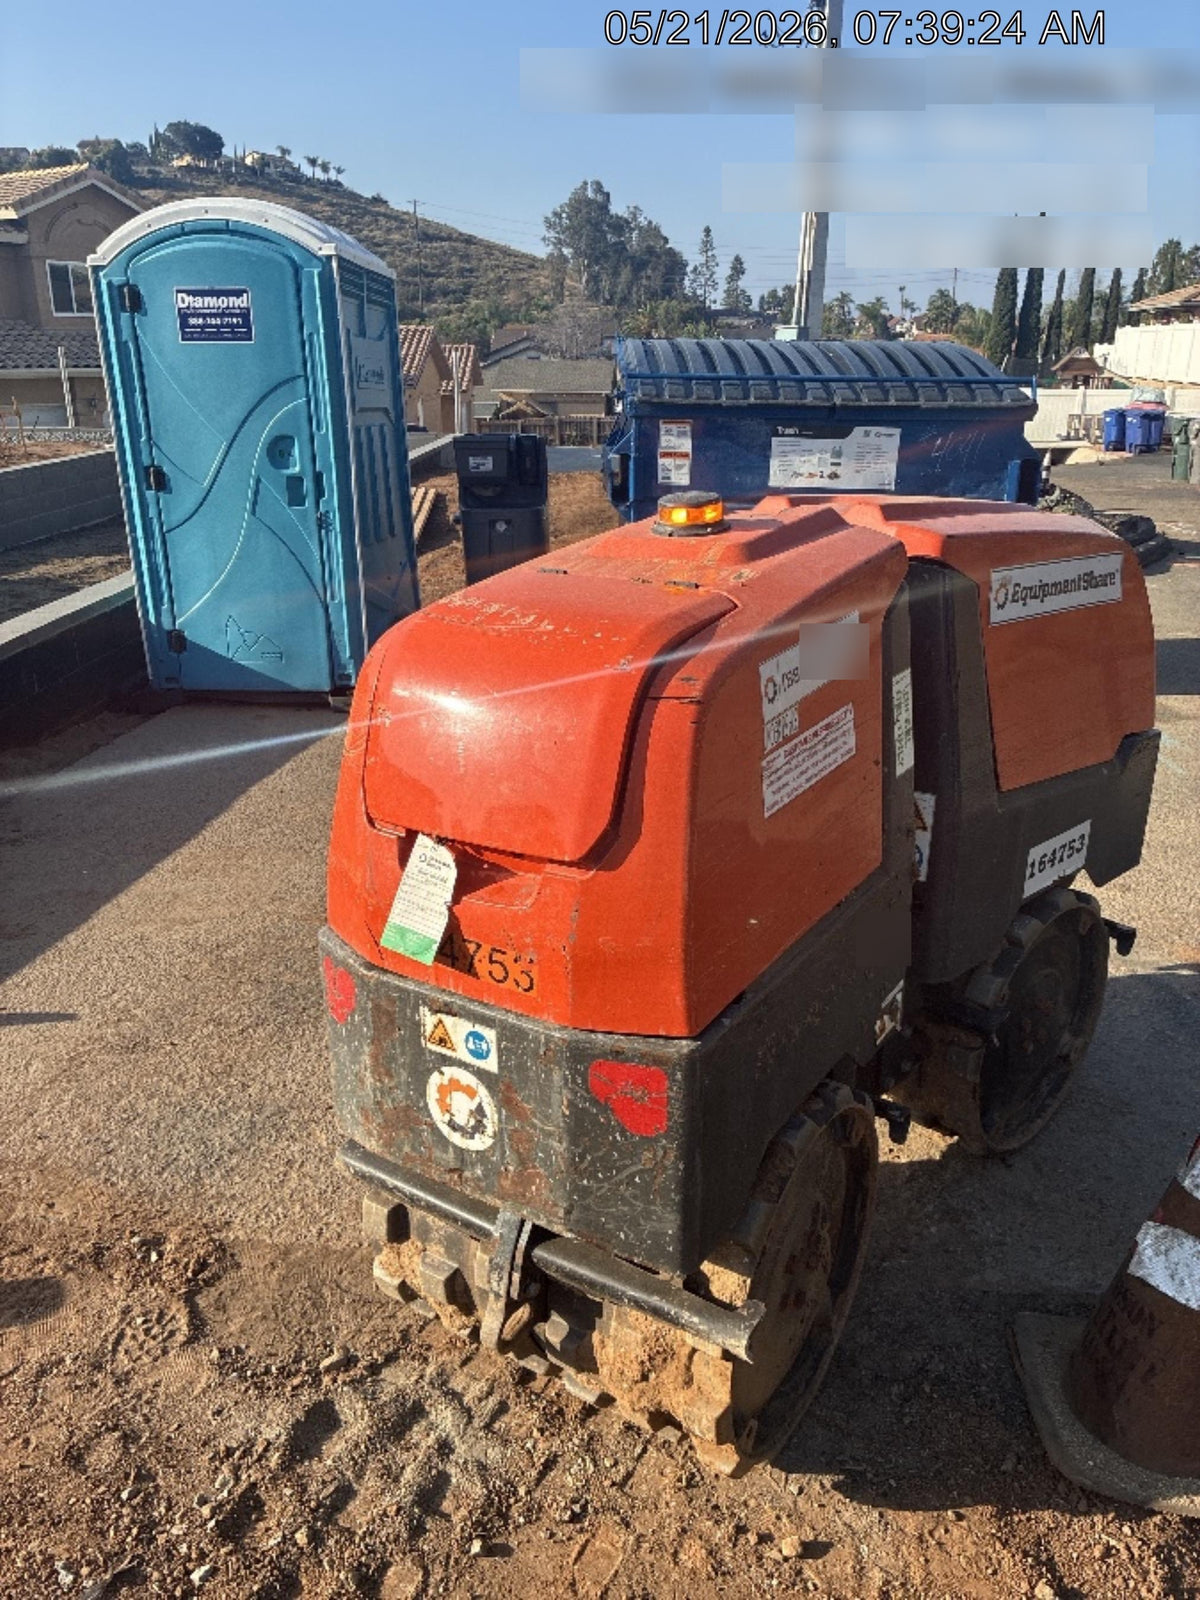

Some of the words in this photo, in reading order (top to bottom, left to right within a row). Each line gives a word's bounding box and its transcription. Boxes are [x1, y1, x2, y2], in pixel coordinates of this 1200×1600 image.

[177, 292, 248, 308] Diamond
[1011, 570, 1116, 607] EquipmentShare
[1027, 833, 1086, 881] 164753
